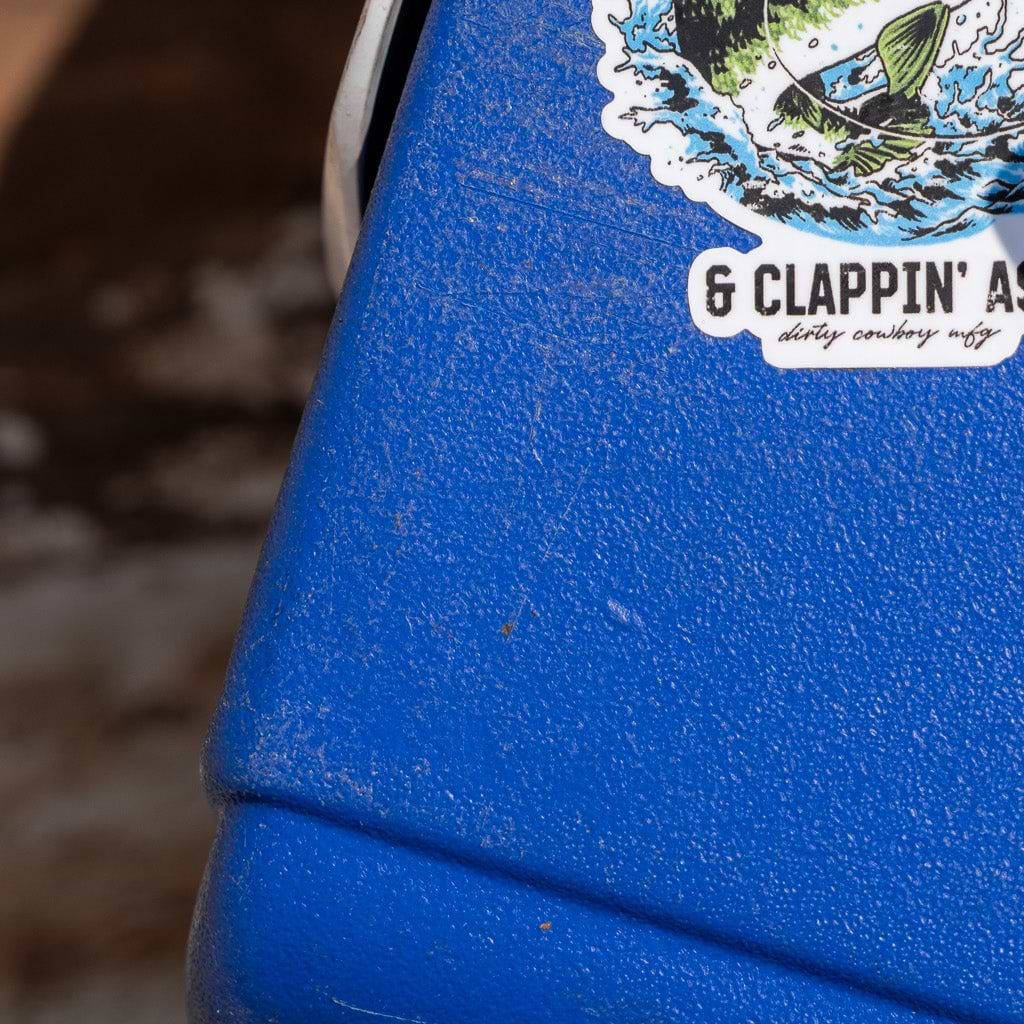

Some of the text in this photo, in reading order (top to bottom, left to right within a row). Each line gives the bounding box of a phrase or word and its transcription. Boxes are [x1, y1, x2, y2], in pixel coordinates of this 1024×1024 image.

[705, 264, 736, 317] &
[753, 260, 968, 316] CLAPPIN'
[778, 319, 1002, 351] dirty cowboy mfg
